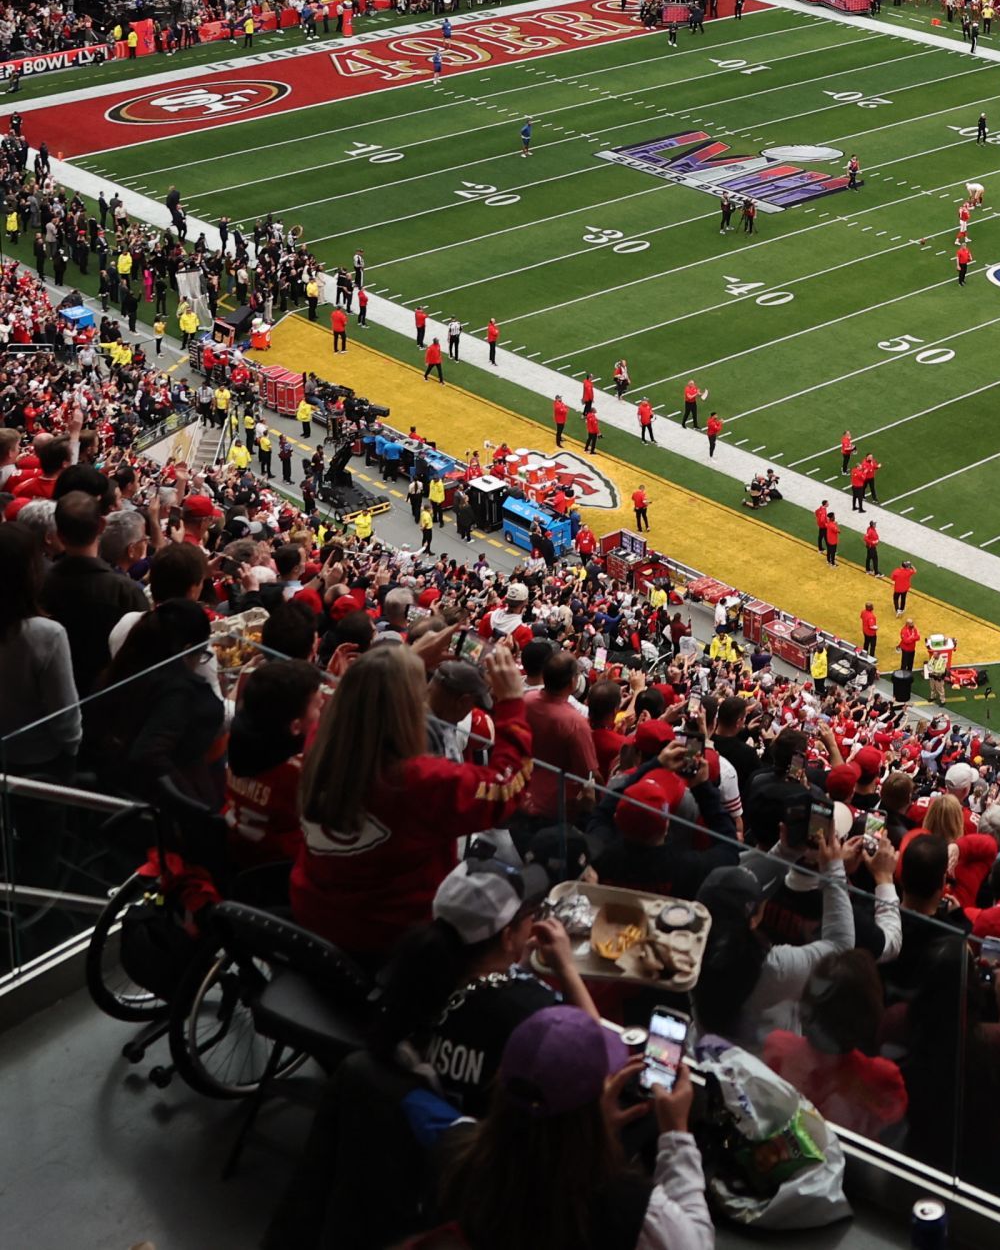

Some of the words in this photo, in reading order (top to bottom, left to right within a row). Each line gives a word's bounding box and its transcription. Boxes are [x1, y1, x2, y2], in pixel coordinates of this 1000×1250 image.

[204, 60, 236, 72] IT
[245, 40, 347, 64] TAKES
[350, 27, 410, 41] ALL
[454, 10, 499, 22] US
[23, 53, 73, 75] BOWL
[717, 59, 772, 75] 10
[150, 89, 259, 115] SF
[833, 91, 893, 109] 20
[344, 141, 405, 164] 10
[612, 156, 688, 183] SUPER
[454, 182, 521, 207] 20
[582, 228, 651, 253] 30
[723, 280, 795, 307] 40
[877, 335, 956, 365] 50
